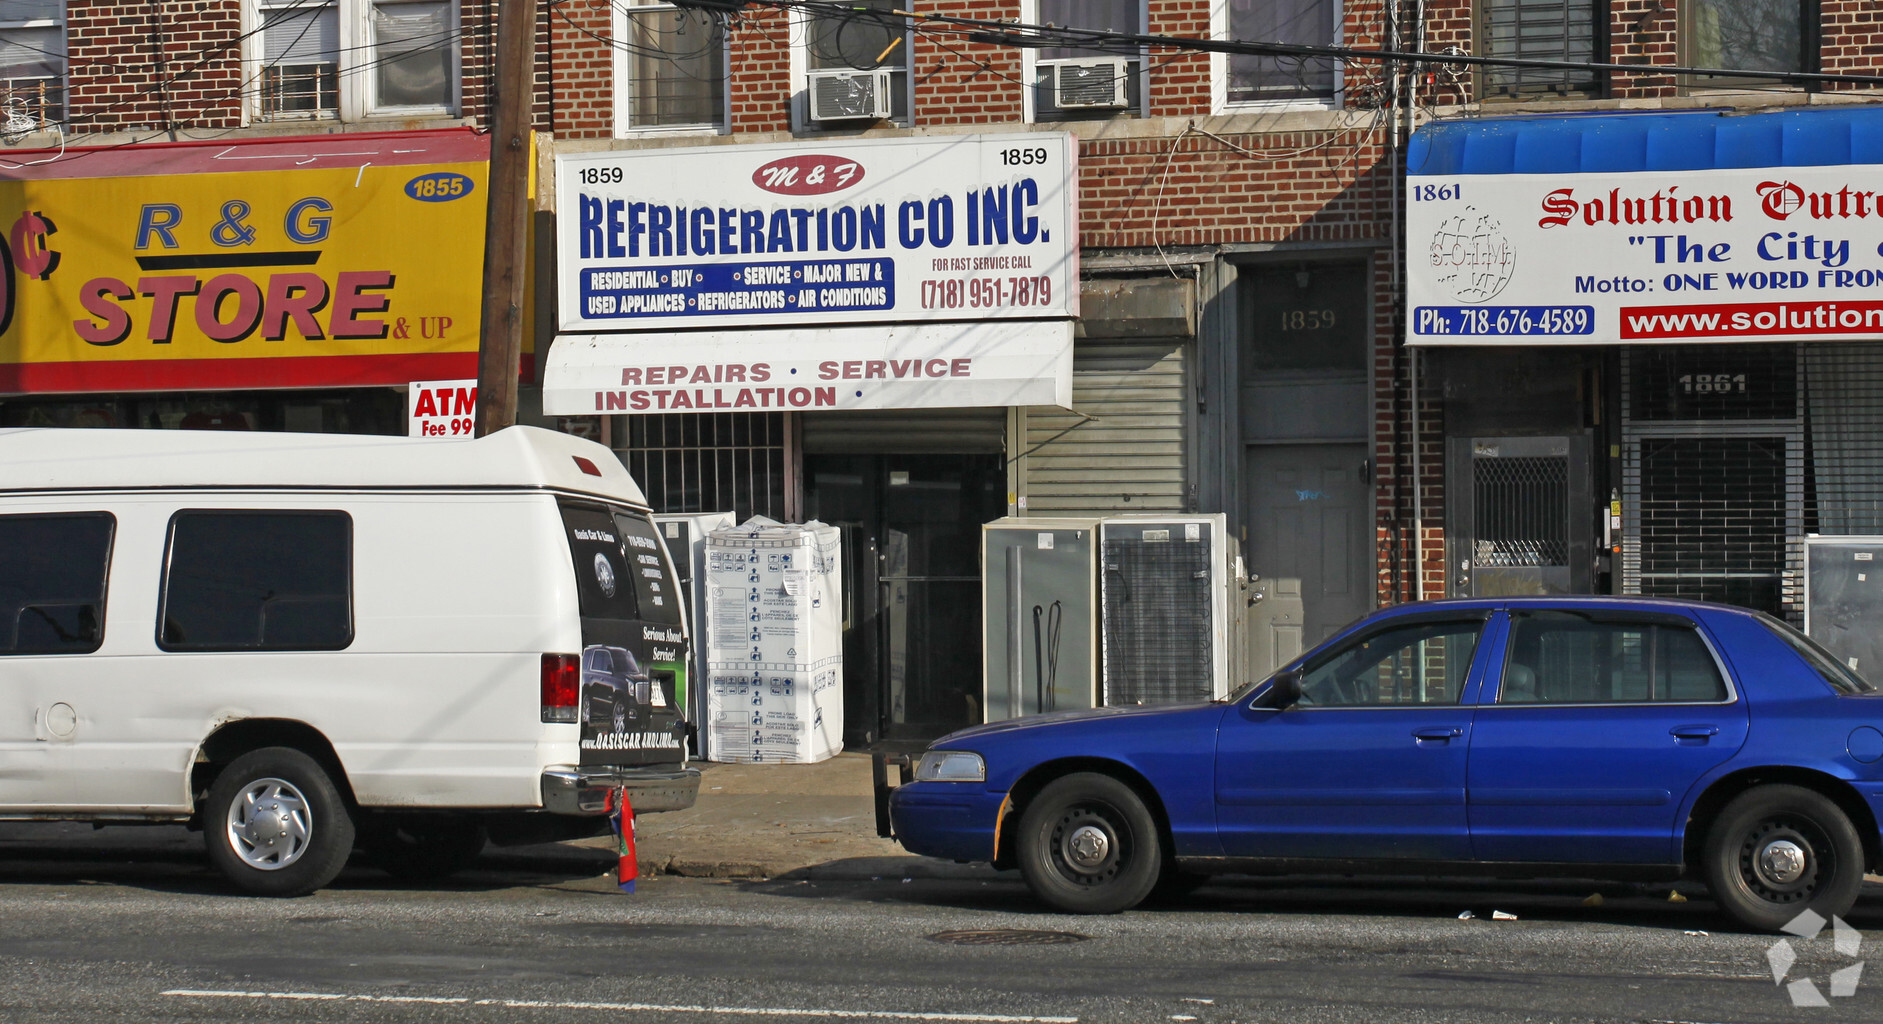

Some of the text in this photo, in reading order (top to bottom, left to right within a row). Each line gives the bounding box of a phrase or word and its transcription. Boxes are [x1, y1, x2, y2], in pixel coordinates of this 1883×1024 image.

[999, 147, 1048, 166] 1859
[412, 176, 465, 198] 1855
[579, 167, 624, 185] 1859
[762, 163, 858, 188] M & F
[1413, 183, 1461, 202] 1861
[579, 177, 1050, 259] REFRIGERATION CO INC.
[1538, 186, 1734, 230] Solution
[134, 197, 334, 250] R & G
[1757, 232, 1850, 267] City
[932, 255, 1032, 272] FOR FAST SERVICE CALL
[591, 262, 883, 291] RESIDENTIAL BUY SERVICE MAJOR NEW &
[1575, 275, 1654, 293] Motto:
[1663, 273, 1719, 292] ONE
[1726, 270, 1809, 290] WORD
[588, 287, 887, 315] USED APPLIANCES REFRIGERATORS AIR CONDITIONS
[921, 275, 1052, 310] (718) 951-7879
[73, 270, 396, 347] STORE
[1282, 309, 1336, 332] 1859
[392, 316, 454, 340] & UP
[1419, 309, 1588, 334] Ph: 718-676-4589
[621, 358, 973, 387] REPAIRS SERVICE
[1679, 374, 1747, 394] 1861
[414, 387, 478, 417] ATM
[595, 386, 837, 411] INSTALLATION
[422, 418, 476, 436] Fee 99
[643, 626, 682, 643] Serious About
[652, 647, 676, 661] Service!
